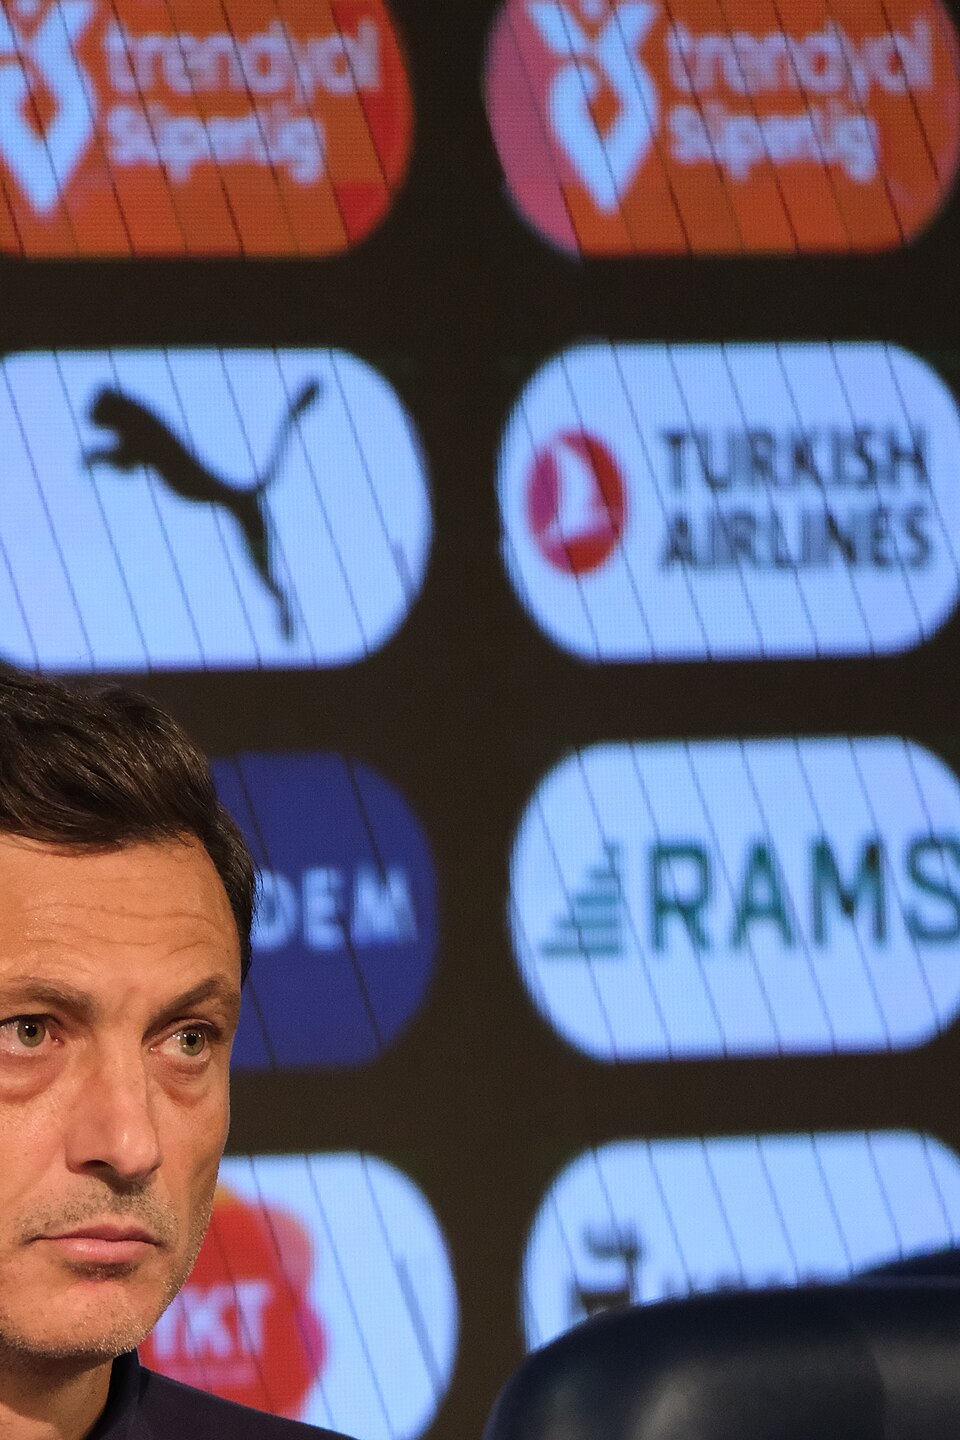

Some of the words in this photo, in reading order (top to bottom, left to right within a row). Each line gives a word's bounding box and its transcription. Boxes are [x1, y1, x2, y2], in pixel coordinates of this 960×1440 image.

[662, 428, 929, 492] TURKISH
[661, 505, 932, 574] AIRLINES
[650, 836, 960, 955] RAMS
